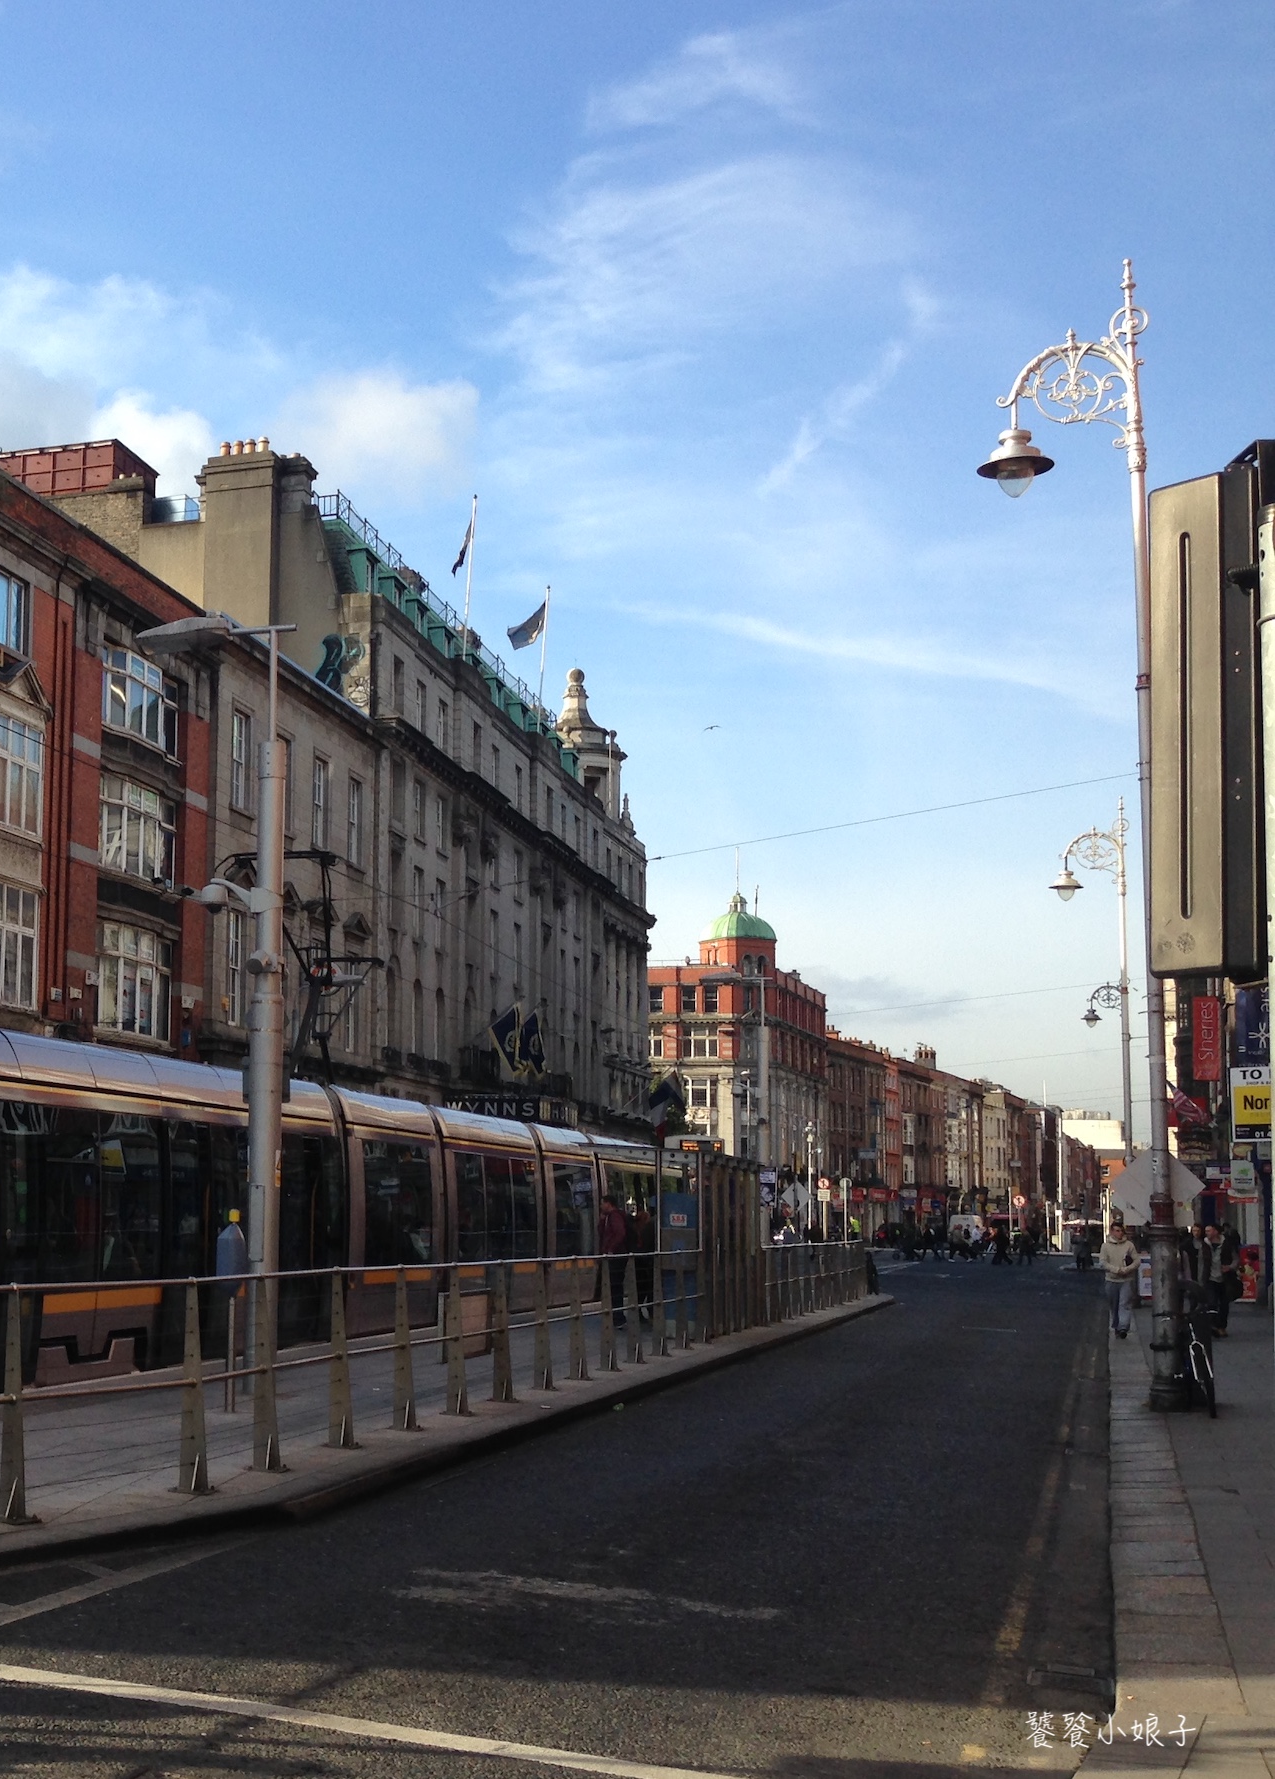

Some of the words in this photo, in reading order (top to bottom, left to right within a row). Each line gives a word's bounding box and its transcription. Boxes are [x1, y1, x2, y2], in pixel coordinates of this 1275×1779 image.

[1198, 1001, 1214, 1060] Sheries
[1239, 1069, 1262, 1080] TO
[446, 1101, 535, 1117] WYNNS
